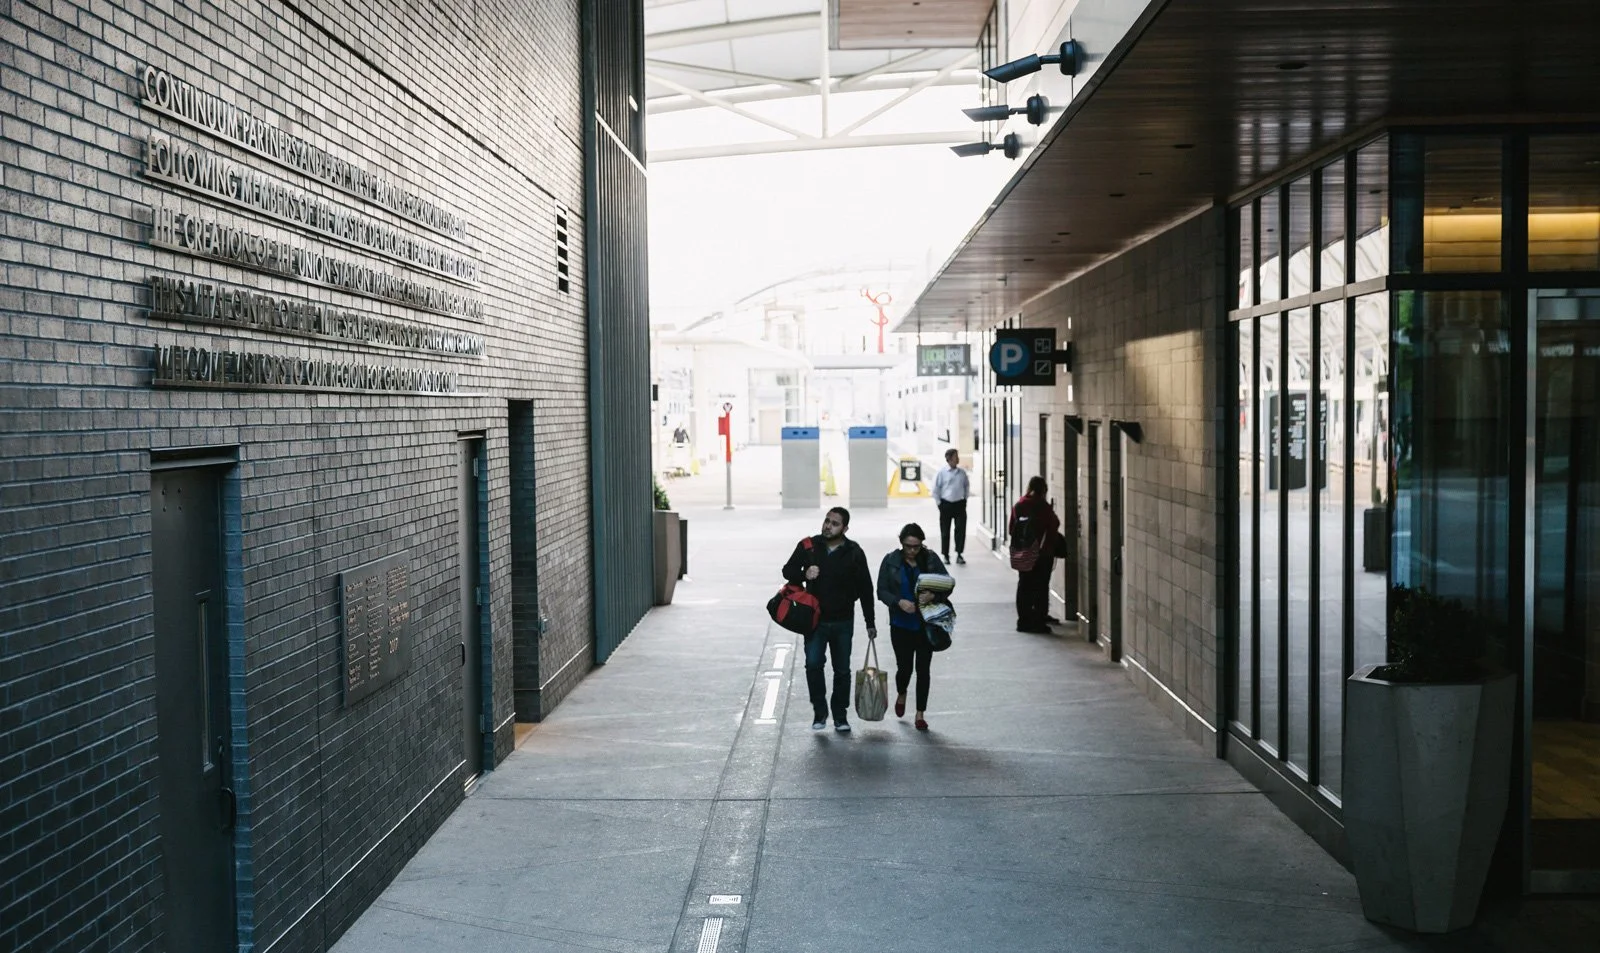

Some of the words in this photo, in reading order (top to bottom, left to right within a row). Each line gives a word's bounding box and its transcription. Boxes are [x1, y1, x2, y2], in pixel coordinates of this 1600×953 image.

[144, 65, 238, 139] CONTINUUM
[243, 110, 297, 164] PARTNERS
[302, 140, 322, 176] AND
[325, 153, 347, 188] EAST
[350, 167, 375, 199] WEST
[377, 179, 409, 215] PARTNERS
[147, 136, 237, 200] FOLLOWING
[241, 170, 296, 219] MEMBERS
[298, 195, 314, 226] OF
[317, 203, 333, 233] THE
[335, 208, 367, 245] MASTER
[369, 223, 411, 260] DEVELOPER
[412, 239, 429, 267] TEAM
[430, 246, 442, 271] FOR
[152, 205, 180, 244] THE
[184, 214, 250, 264] CREATION
[254, 234, 273, 269] OF
[276, 241, 296, 275] THE
[298, 247, 330, 283] UNION
[333, 259, 370, 293] STATION
[373, 272, 402, 301] TRANSIT
[403, 281, 428, 306] CENTER
[429, 288, 442, 310] AND
[151, 275, 185, 315] THIS
[189, 281, 226, 320] VITAL
[231, 287, 275, 326] CENTER
[279, 296, 295, 330] OF
[297, 300, 317, 333] LIFE
[342, 310, 368, 340] SERVE
[369, 314, 406, 346] RESIDENTS
[407, 322, 418, 348] OF
[419, 325, 442, 351] DENVER
[443, 329, 455, 352] AND
[1000, 343, 1022, 371] P
[155, 343, 228, 383] WELCOME
[231, 350, 286, 385] VISITORS
[288, 354, 303, 386] TO
[306, 356, 328, 387] OUR
[331, 358, 364, 388] REGION
[366, 362, 383, 389] FOR
[384, 365, 432, 392] GENERATIONS
[433, 369, 440, 392] TO
